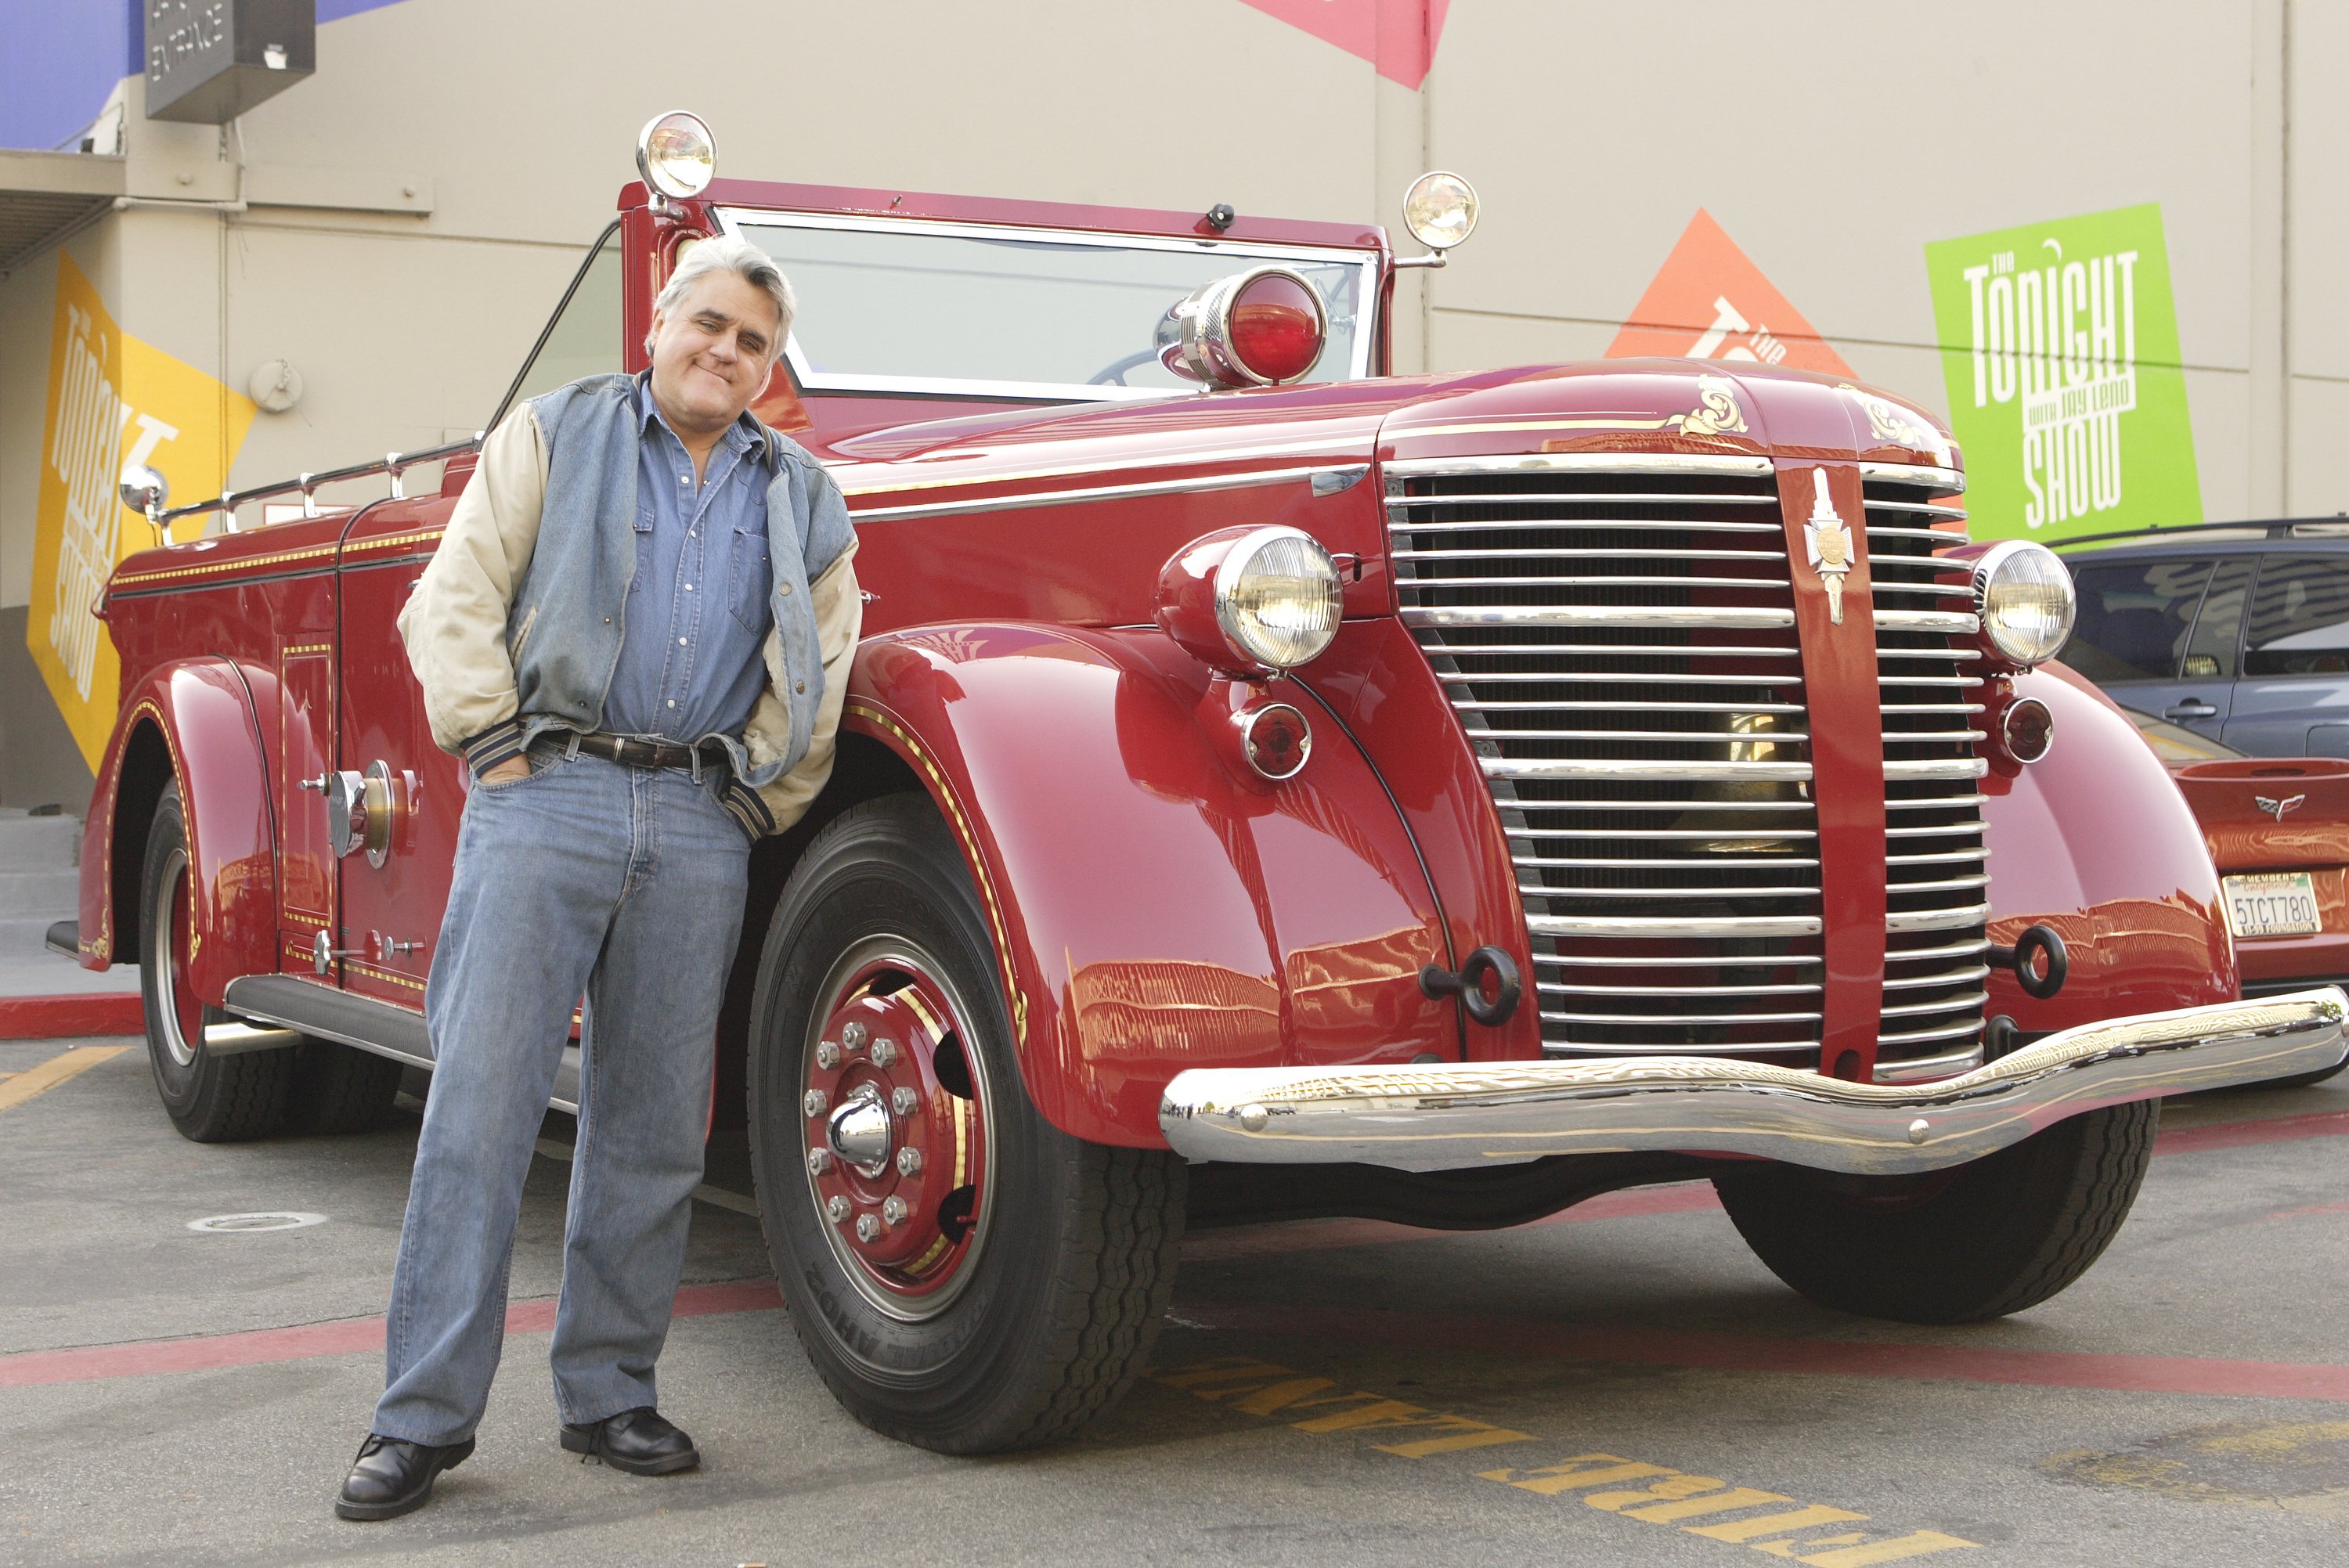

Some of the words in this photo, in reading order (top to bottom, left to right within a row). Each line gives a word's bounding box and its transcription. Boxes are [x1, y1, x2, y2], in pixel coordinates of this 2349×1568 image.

[151, 2, 223, 81] ENTRANCE
[2023, 413, 2122, 529] SHOW
[2245, 873, 2289, 883] MEMBER
[2235, 896, 2312, 925] 5TCT780
